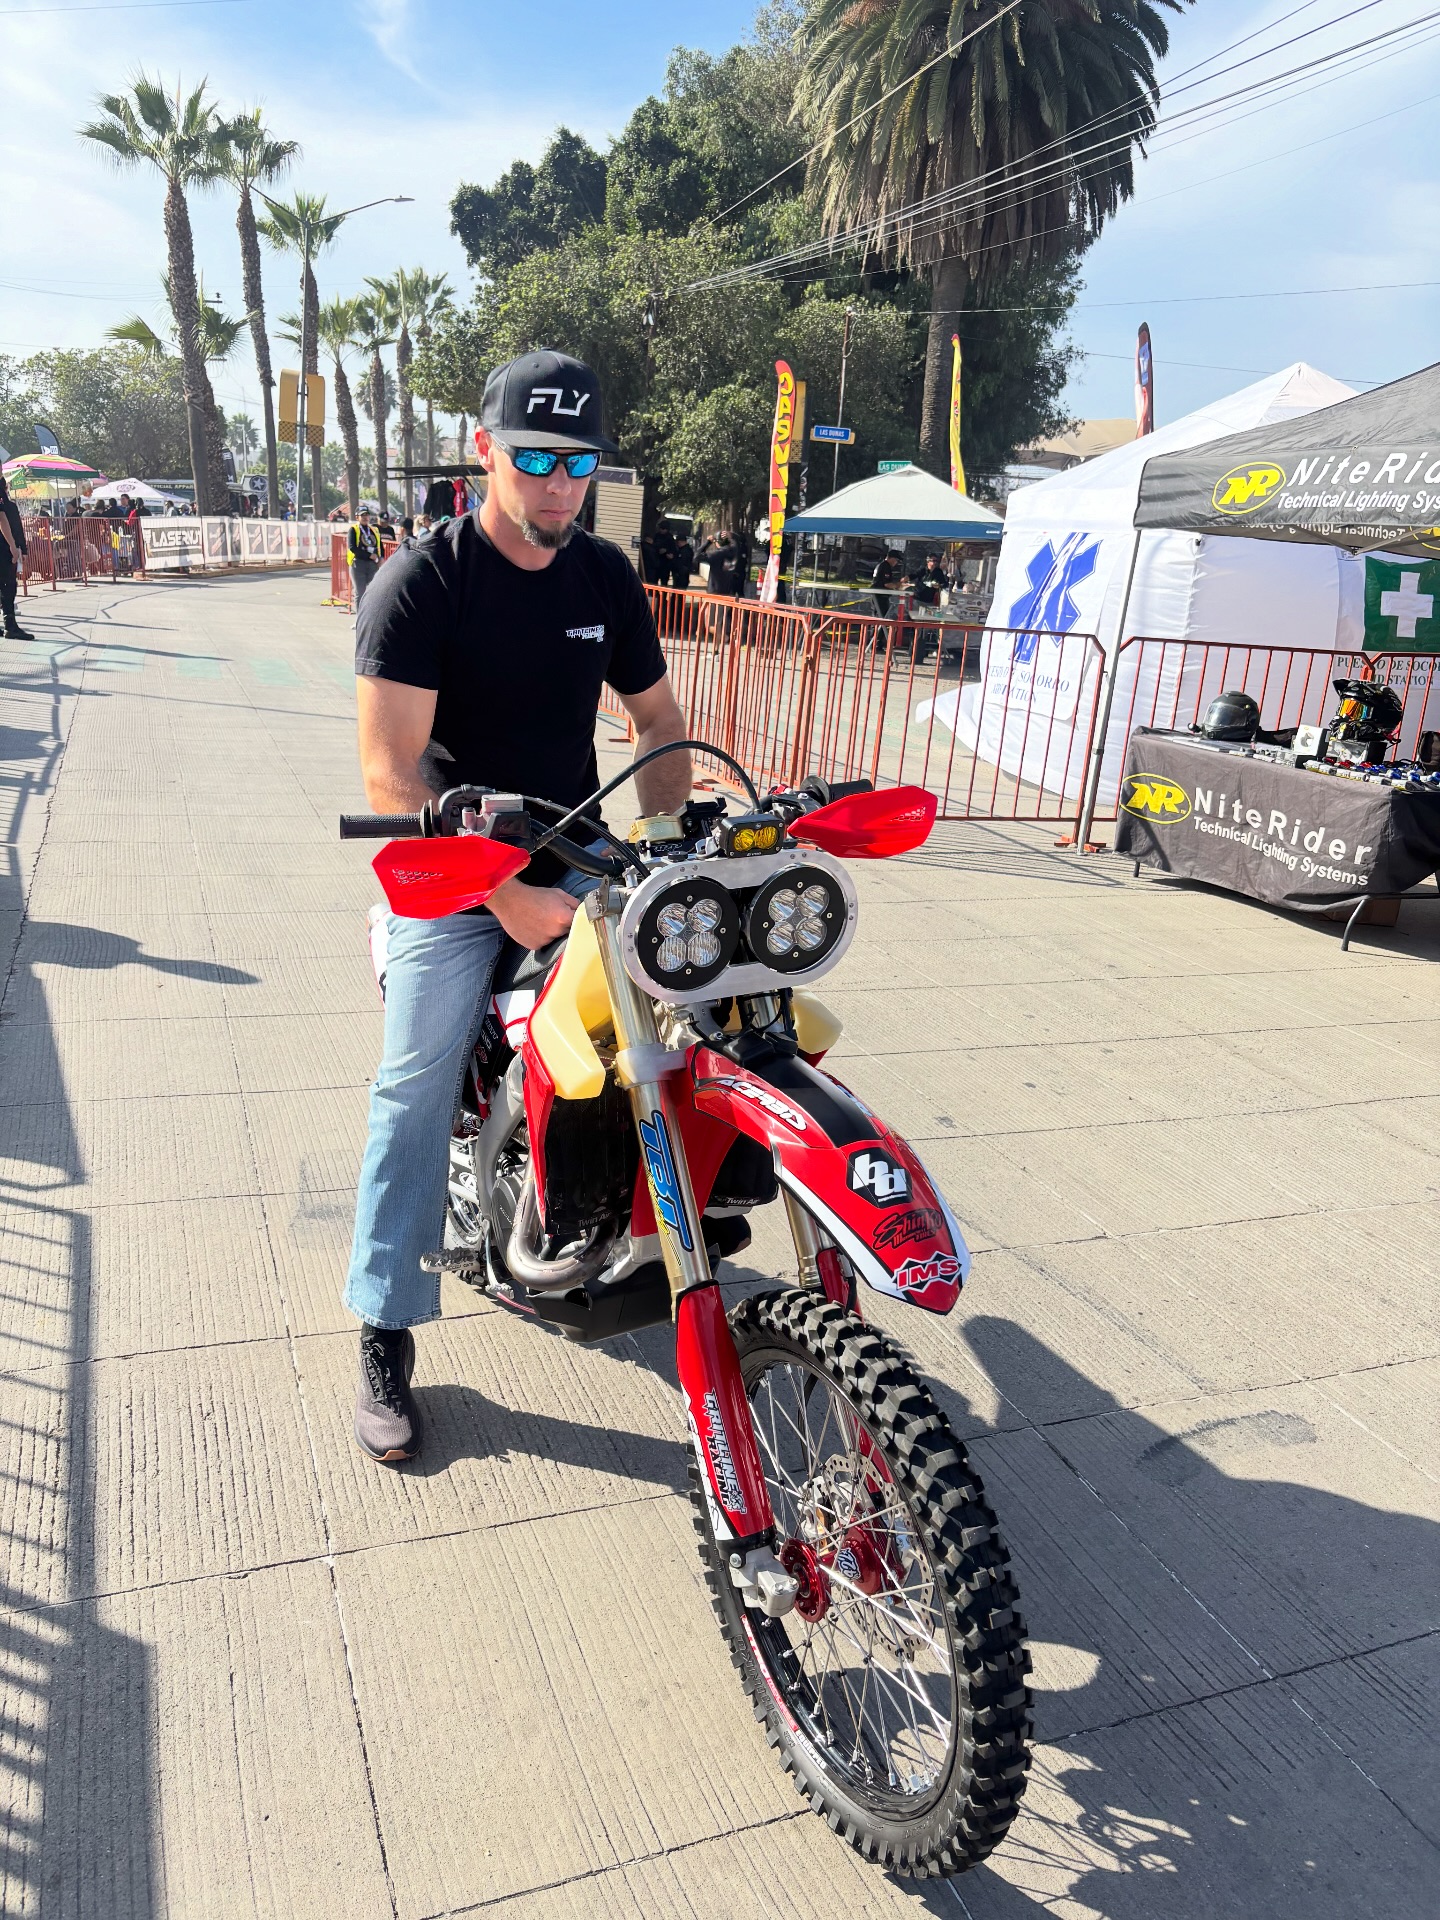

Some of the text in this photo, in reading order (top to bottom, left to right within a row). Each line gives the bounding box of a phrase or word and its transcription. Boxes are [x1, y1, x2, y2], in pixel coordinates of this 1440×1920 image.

[527, 388, 590, 417] FLY
[819, 428, 845, 438] LAS DUNAS
[1277, 490, 1346, 509] Technical
[1343, 490, 1410, 513] Lighting
[1194, 786, 1372, 865] NiteRider
[1193, 815, 1369, 886] Technical Lighting Systems
[897, 1258, 960, 1291] IMS
